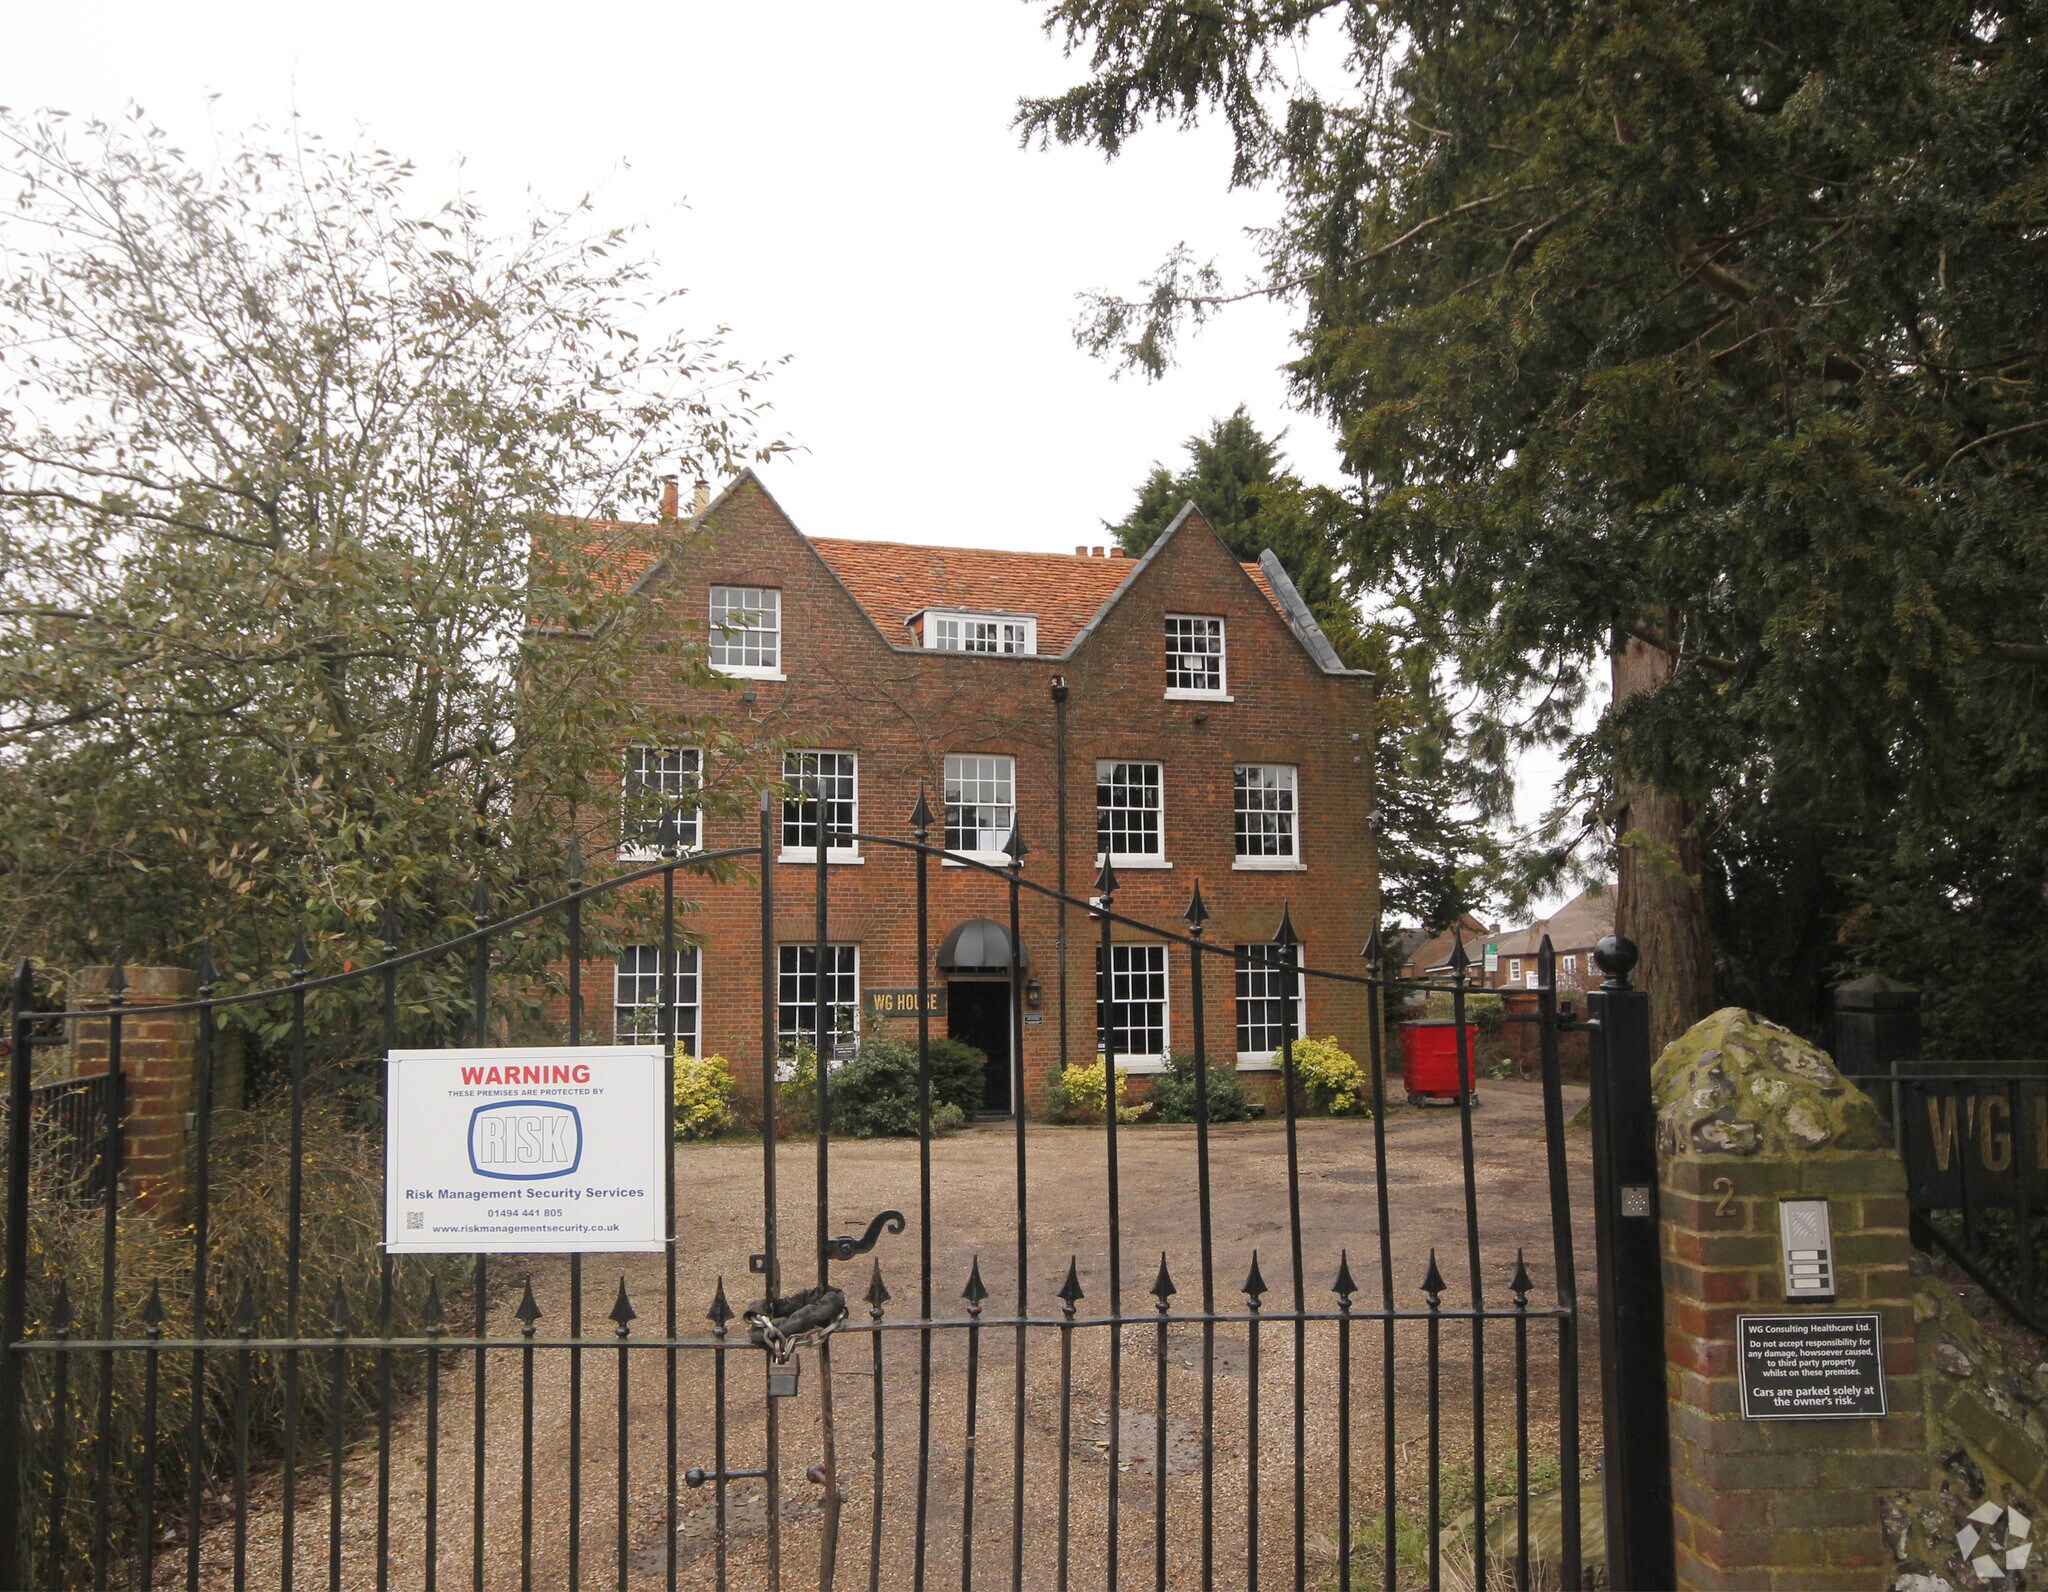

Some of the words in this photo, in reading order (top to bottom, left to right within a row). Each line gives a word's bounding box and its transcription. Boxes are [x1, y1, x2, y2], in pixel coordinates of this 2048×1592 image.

[873, 994, 893, 1010] WG
[897, 993, 937, 1010] HOUE
[461, 1064, 591, 1085] WARNING
[477, 1089, 519, 1097] PREMISES
[540, 1088, 590, 1096] PROTECTED
[1927, 1094, 2012, 1172] WG
[480, 1115, 569, 1164] RISK
[405, 1189, 434, 1200] Risk
[438, 1189, 522, 1201] Management
[526, 1188, 582, 1200] Security
[586, 1187, 644, 1198] Services
[1712, 1177, 1737, 1217] 2
[487, 1209, 519, 1218] 01494
[521, 1209, 540, 1217] 441
[543, 1208, 563, 1217] 805
[432, 1223, 620, 1234] www.riskmanagementsecurity.co.uk
[1748, 1325, 1763, 1334] WG
[1765, 1325, 1809, 1335] Consulting
[1811, 1324, 1854, 1333] Healthcare
[1855, 1323, 1871, 1332] Ltd.
[1750, 1340, 1762, 1348] Do
[1763, 1340, 1777, 1348] not
[1778, 1340, 1804, 1349] accept
[1805, 1338, 1857, 1348] responsibility
[1859, 1338, 1871, 1346] for
[1748, 1350, 1762, 1359] any
[1764, 1349, 1798, 1359] damage,
[1800, 1348, 1843, 1357] howsoever
[1844, 1348, 1874, 1356] caused,
[1778, 1359, 1797, 1367] third
[1799, 1359, 1820, 1368] party
[1822, 1358, 1856, 1368] property
[1762, 1369, 1787, 1377] whilst
[1801, 1368, 1823, 1376] these
[1825, 1368, 1861, 1378] premises.
[1753, 1387, 1775, 1397] Cars
[1777, 1389, 1793, 1397] are
[1795, 1386, 1830, 1398] parked
[1832, 1385, 1861, 1397] solely
[1864, 1386, 1875, 1395] at
[1773, 1397, 1791, 1406] the
[1793, 1396, 1833, 1406] owner's
[1835, 1396, 1856, 1405] risk.
